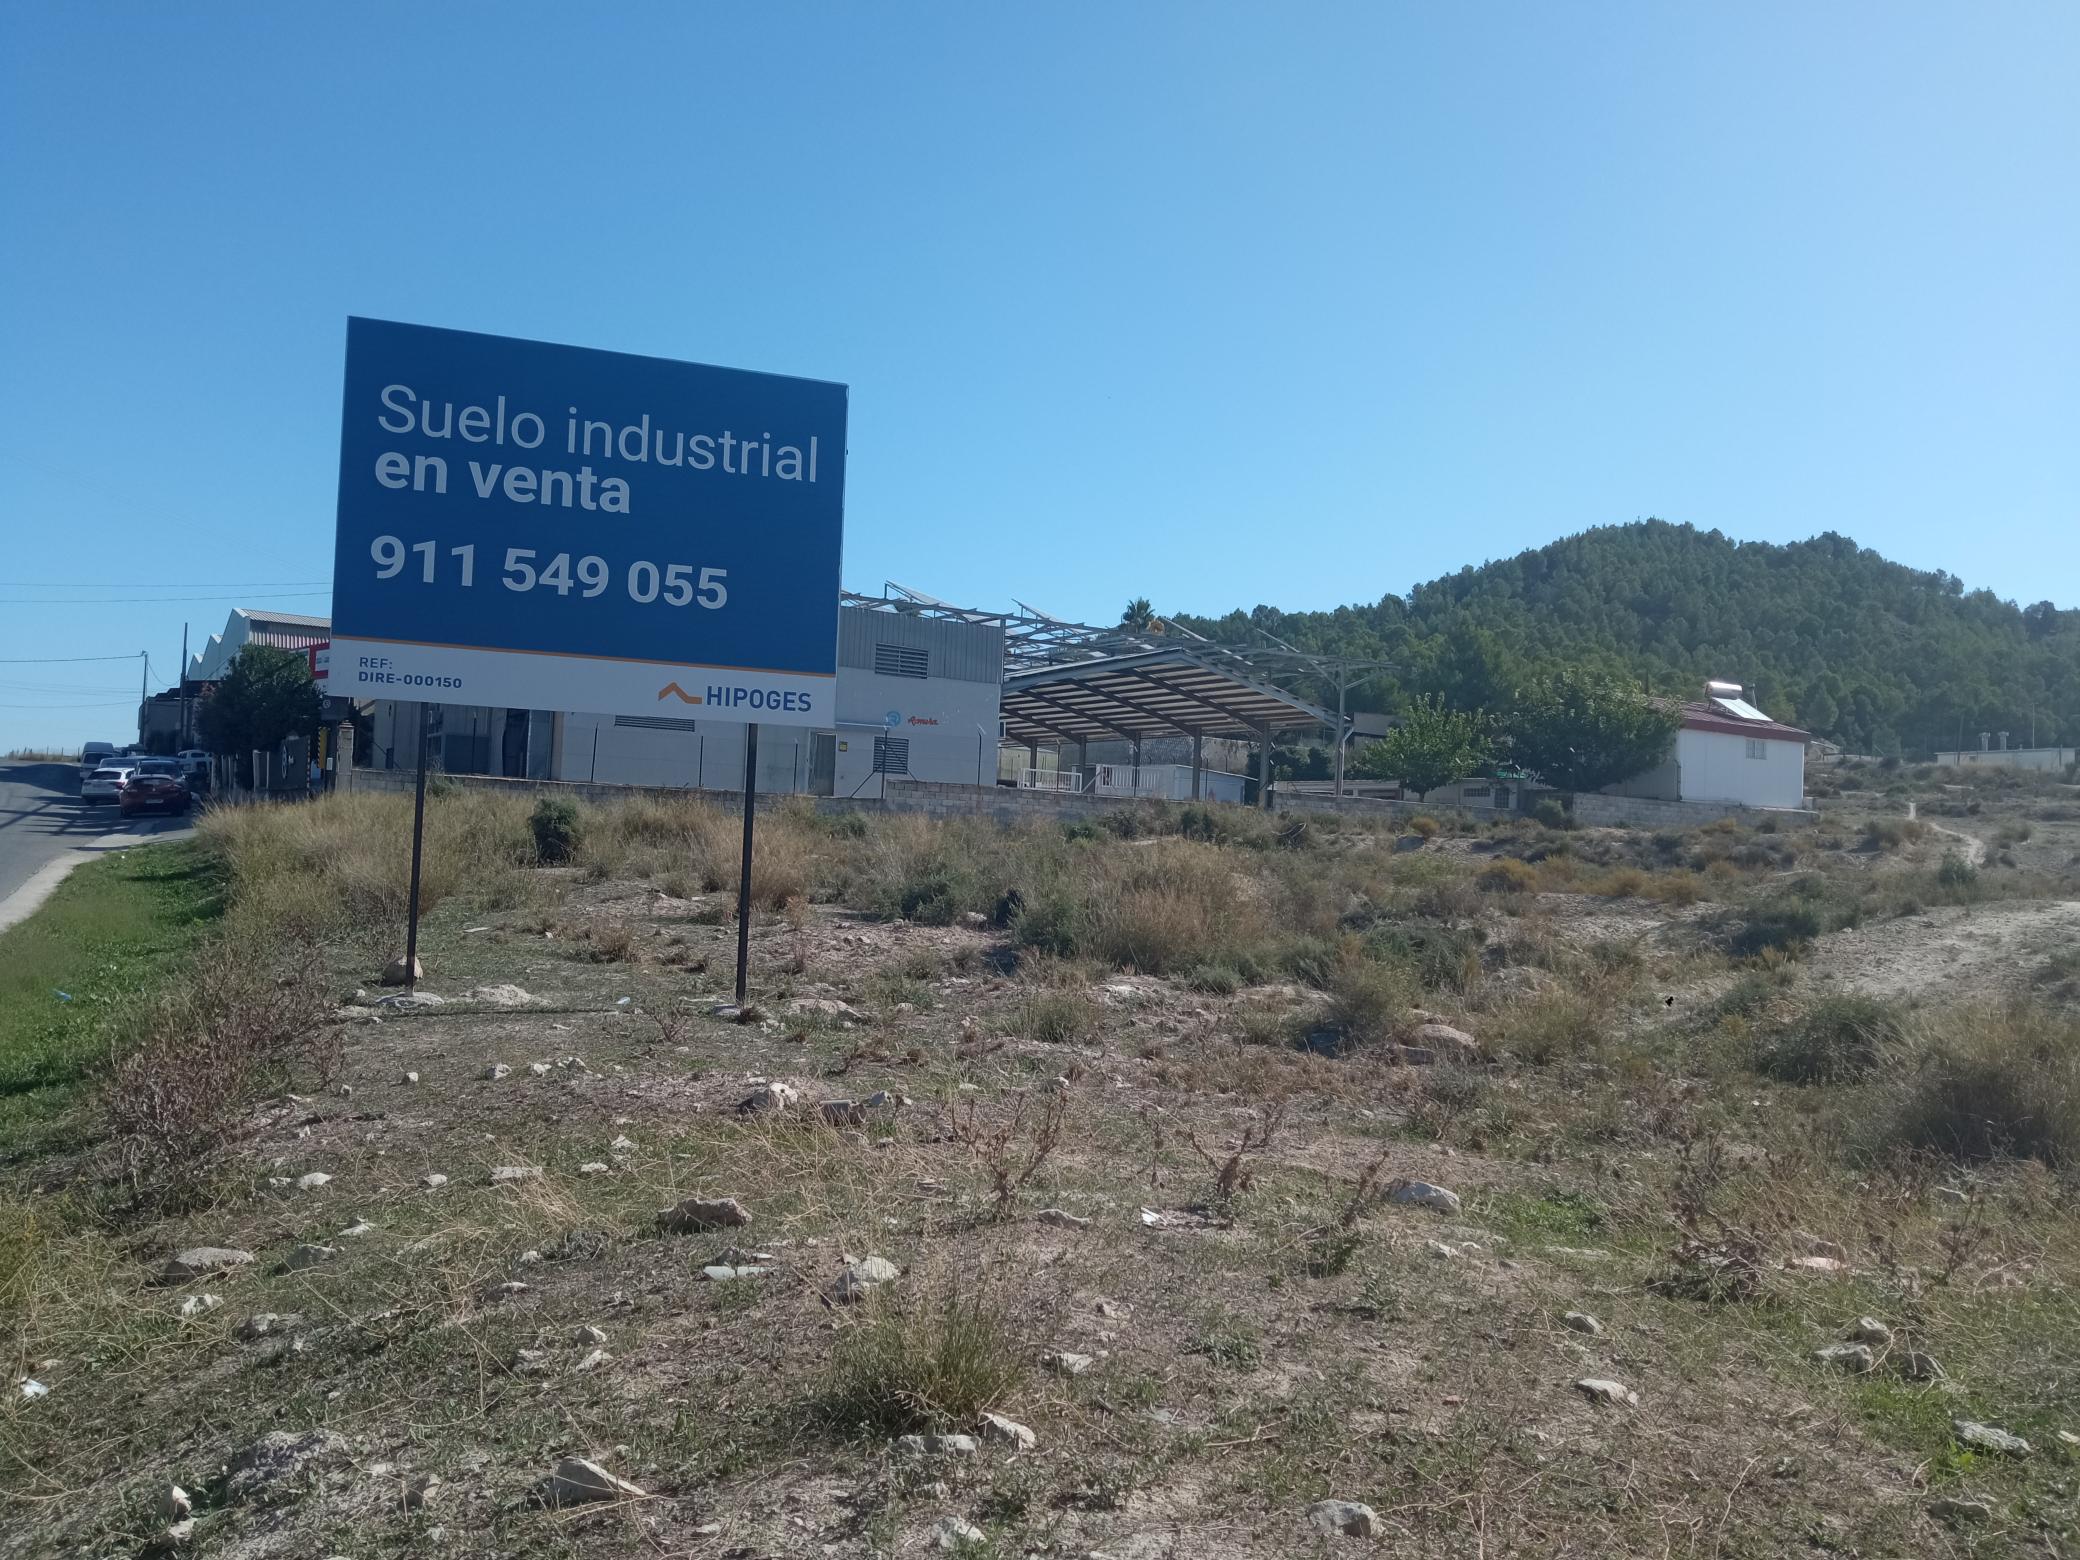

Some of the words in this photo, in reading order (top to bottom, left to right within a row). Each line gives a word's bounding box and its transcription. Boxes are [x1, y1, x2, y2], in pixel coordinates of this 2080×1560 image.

[378, 384, 545, 449] Suelo
[567, 406, 817, 482] industrial
[374, 452, 447, 494] en
[469, 461, 630, 513] venta
[370, 535, 475, 587] 911
[503, 548, 609, 598] 549
[628, 560, 728, 610] 055
[358, 671, 462, 689] DIRE-000150
[359, 656, 393, 669] REF:
[706, 685, 812, 713] HIPOGES
